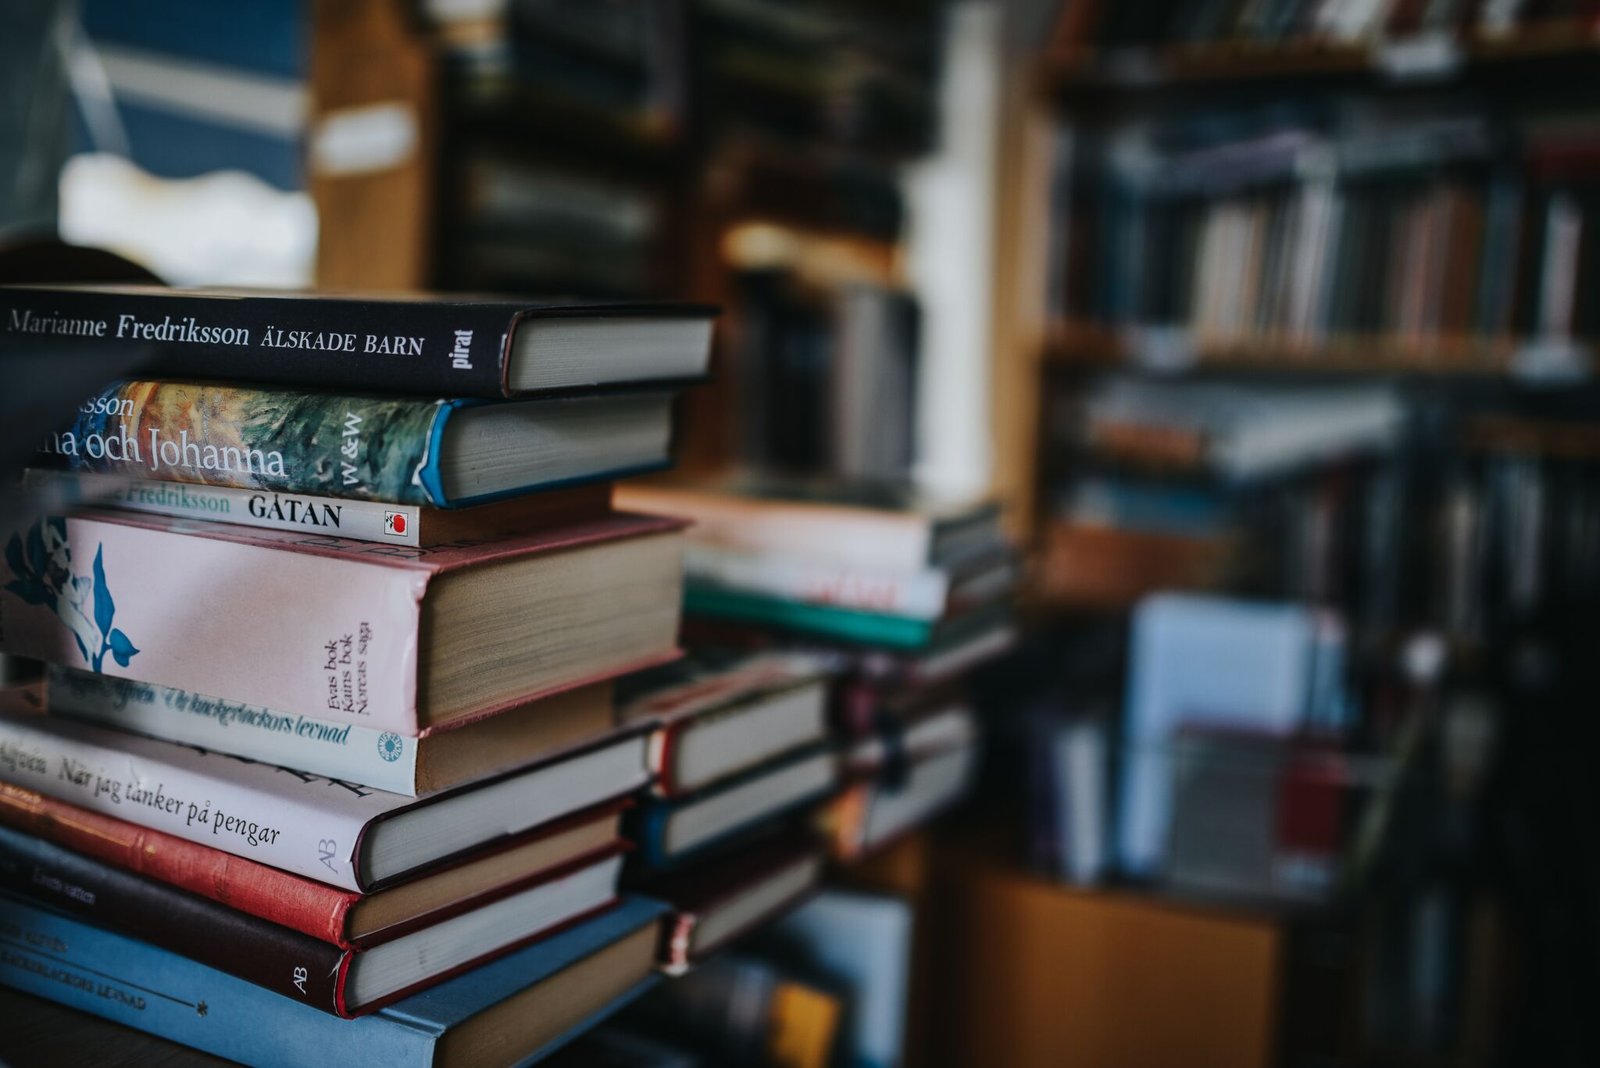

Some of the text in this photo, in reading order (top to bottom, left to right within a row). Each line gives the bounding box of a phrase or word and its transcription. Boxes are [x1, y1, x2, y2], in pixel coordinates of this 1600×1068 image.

[7, 307, 425, 356] Marianne Fredriksson ÄLSKADE BARN
[449, 329, 474, 370] pirat
[86, 424, 143, 462] och
[149, 428, 288, 478] Johanna
[126, 482, 230, 513] Fredriksson
[248, 495, 342, 528] GÅTAN
[324, 640, 338, 670] bok
[338, 634, 352, 664] bok
[294, 715, 352, 745] levnad
[94, 767, 121, 804] jag
[125, 780, 184, 816] tänker
[186, 799, 211, 827] på
[213, 809, 281, 848] pengar
[318, 838, 338, 873] AB
[293, 966, 308, 995] AB
